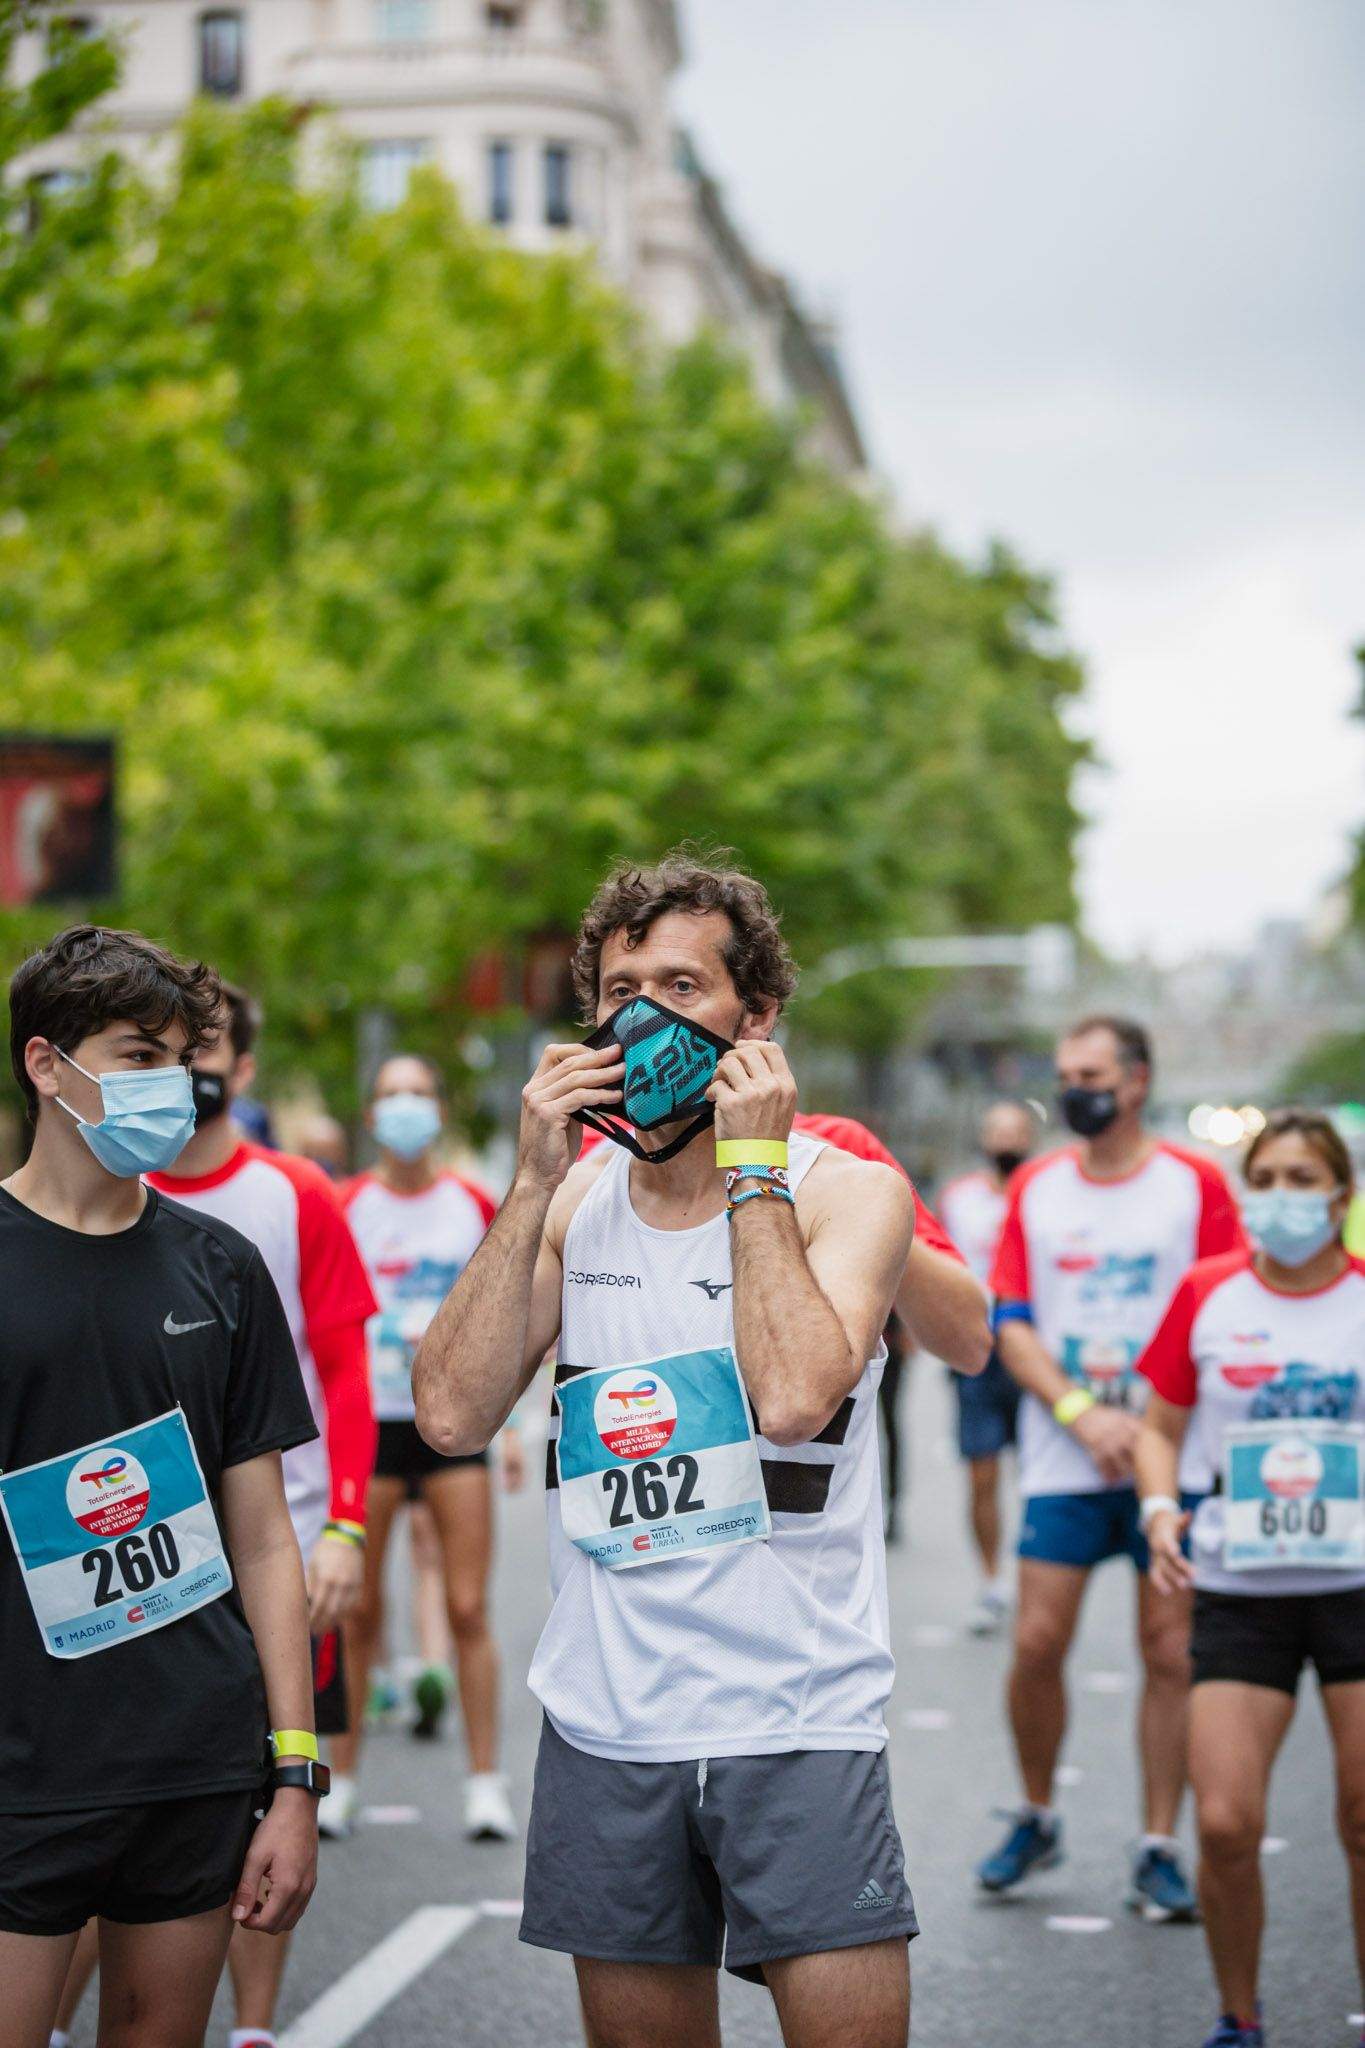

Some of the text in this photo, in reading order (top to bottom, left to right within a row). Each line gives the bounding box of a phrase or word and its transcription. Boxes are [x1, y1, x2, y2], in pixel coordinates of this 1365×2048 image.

[611, 1409, 662, 1424] TotalEnergies
[610, 1431, 670, 1449] INTERNACIONAL
[625, 1427, 650, 1437] MILLA
[631, 1441, 662, 1453] MADRID
[87, 1483, 136, 1506] TotalEnergies
[602, 1454, 706, 1528] 262
[89, 1503, 146, 1530] INTERNACIONAL
[103, 1503, 128, 1516] MILLA
[1261, 1500, 1327, 1535] 600
[100, 1514, 141, 1534] DE MADRID
[651, 1530, 680, 1541] MILLA
[82, 1522, 181, 1608] 260
[143, 1596, 168, 1610] MILLA
[69, 1619, 116, 1643] MADRID
[853, 1896, 893, 1910] adidas
